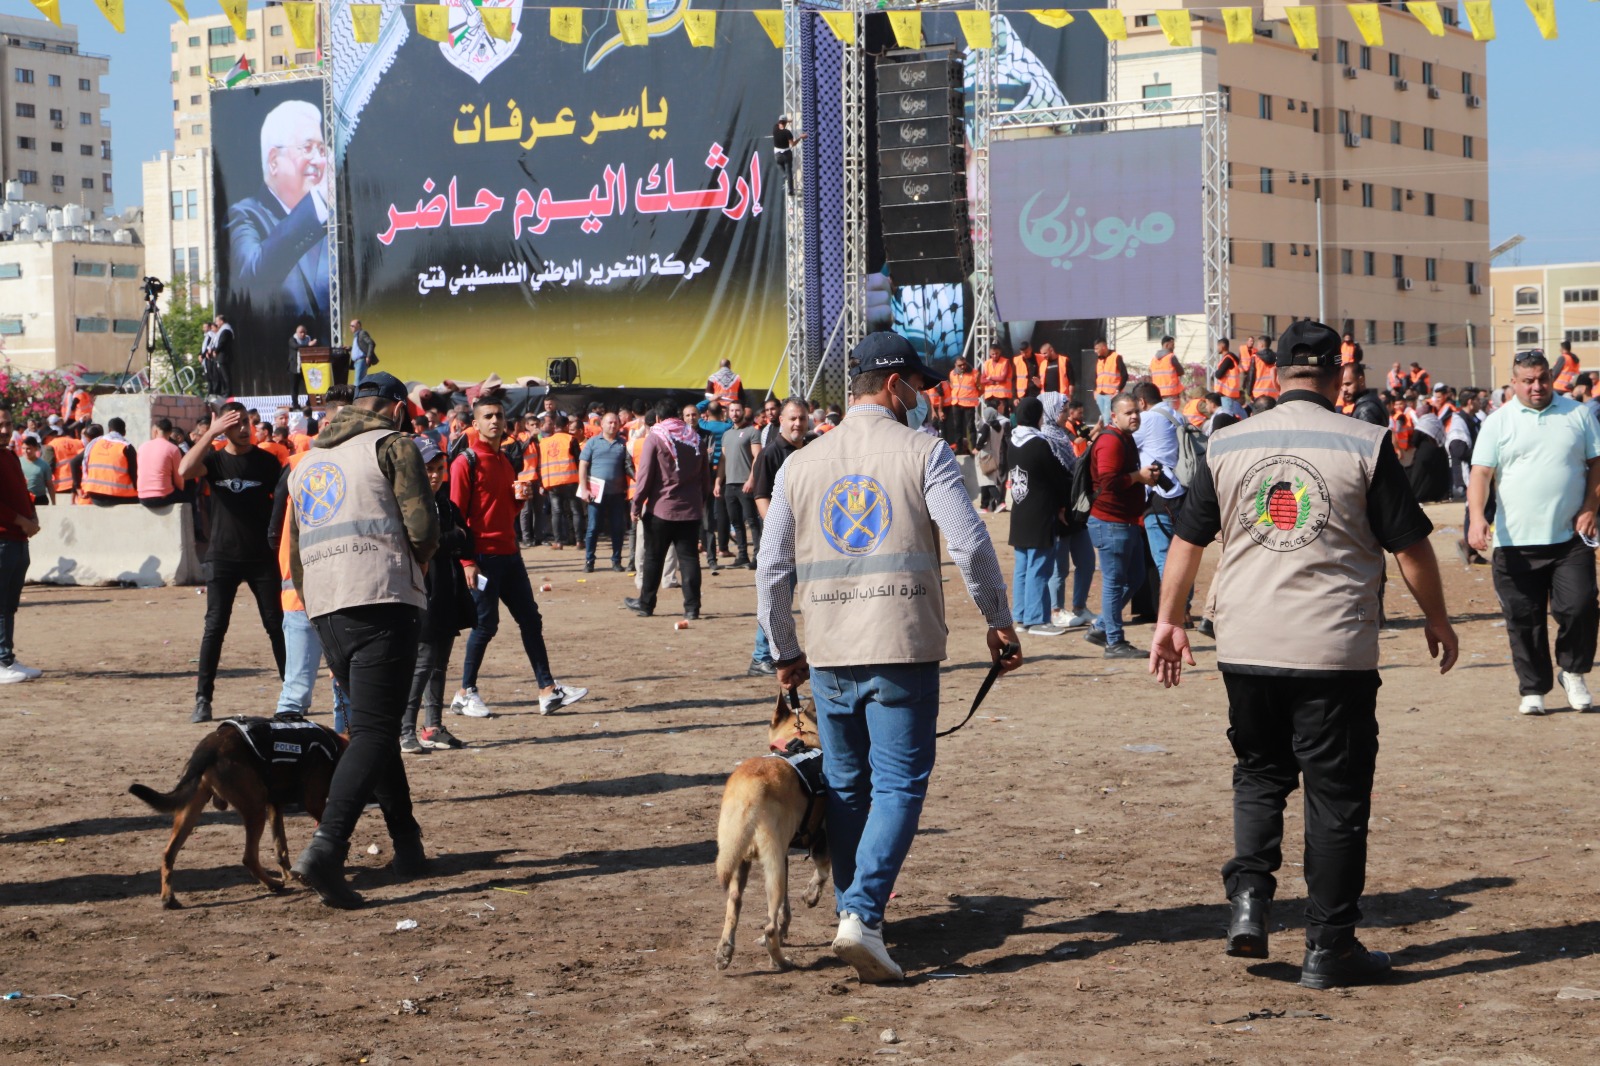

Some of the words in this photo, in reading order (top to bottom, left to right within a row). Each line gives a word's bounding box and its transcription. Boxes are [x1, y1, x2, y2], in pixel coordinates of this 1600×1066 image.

[453, 98, 577, 150] عرفات
[581, 86, 668, 145] ياسر
[635, 142, 763, 220] إرثك
[377, 175, 505, 245] حاضر
[513, 162, 627, 240] اليوم
[418, 266, 446, 295] فتح
[448, 261, 528, 295] الفلسطيني
[530, 258, 583, 291] الوطني
[584, 254, 647, 286] التحرير
[649, 252, 710, 280] حركة
[1240, 512, 1277, 548] PALESTINIAN
[1280, 535, 1307, 548] POLICE
[321, 543, 348, 560] الكلاب
[352, 542, 379, 555] دائرة
[811, 588, 858, 605] البوليسية
[860, 584, 895, 602] الكلاب
[900, 584, 927, 600] دائرة
[274, 743, 300, 753] POLICE
